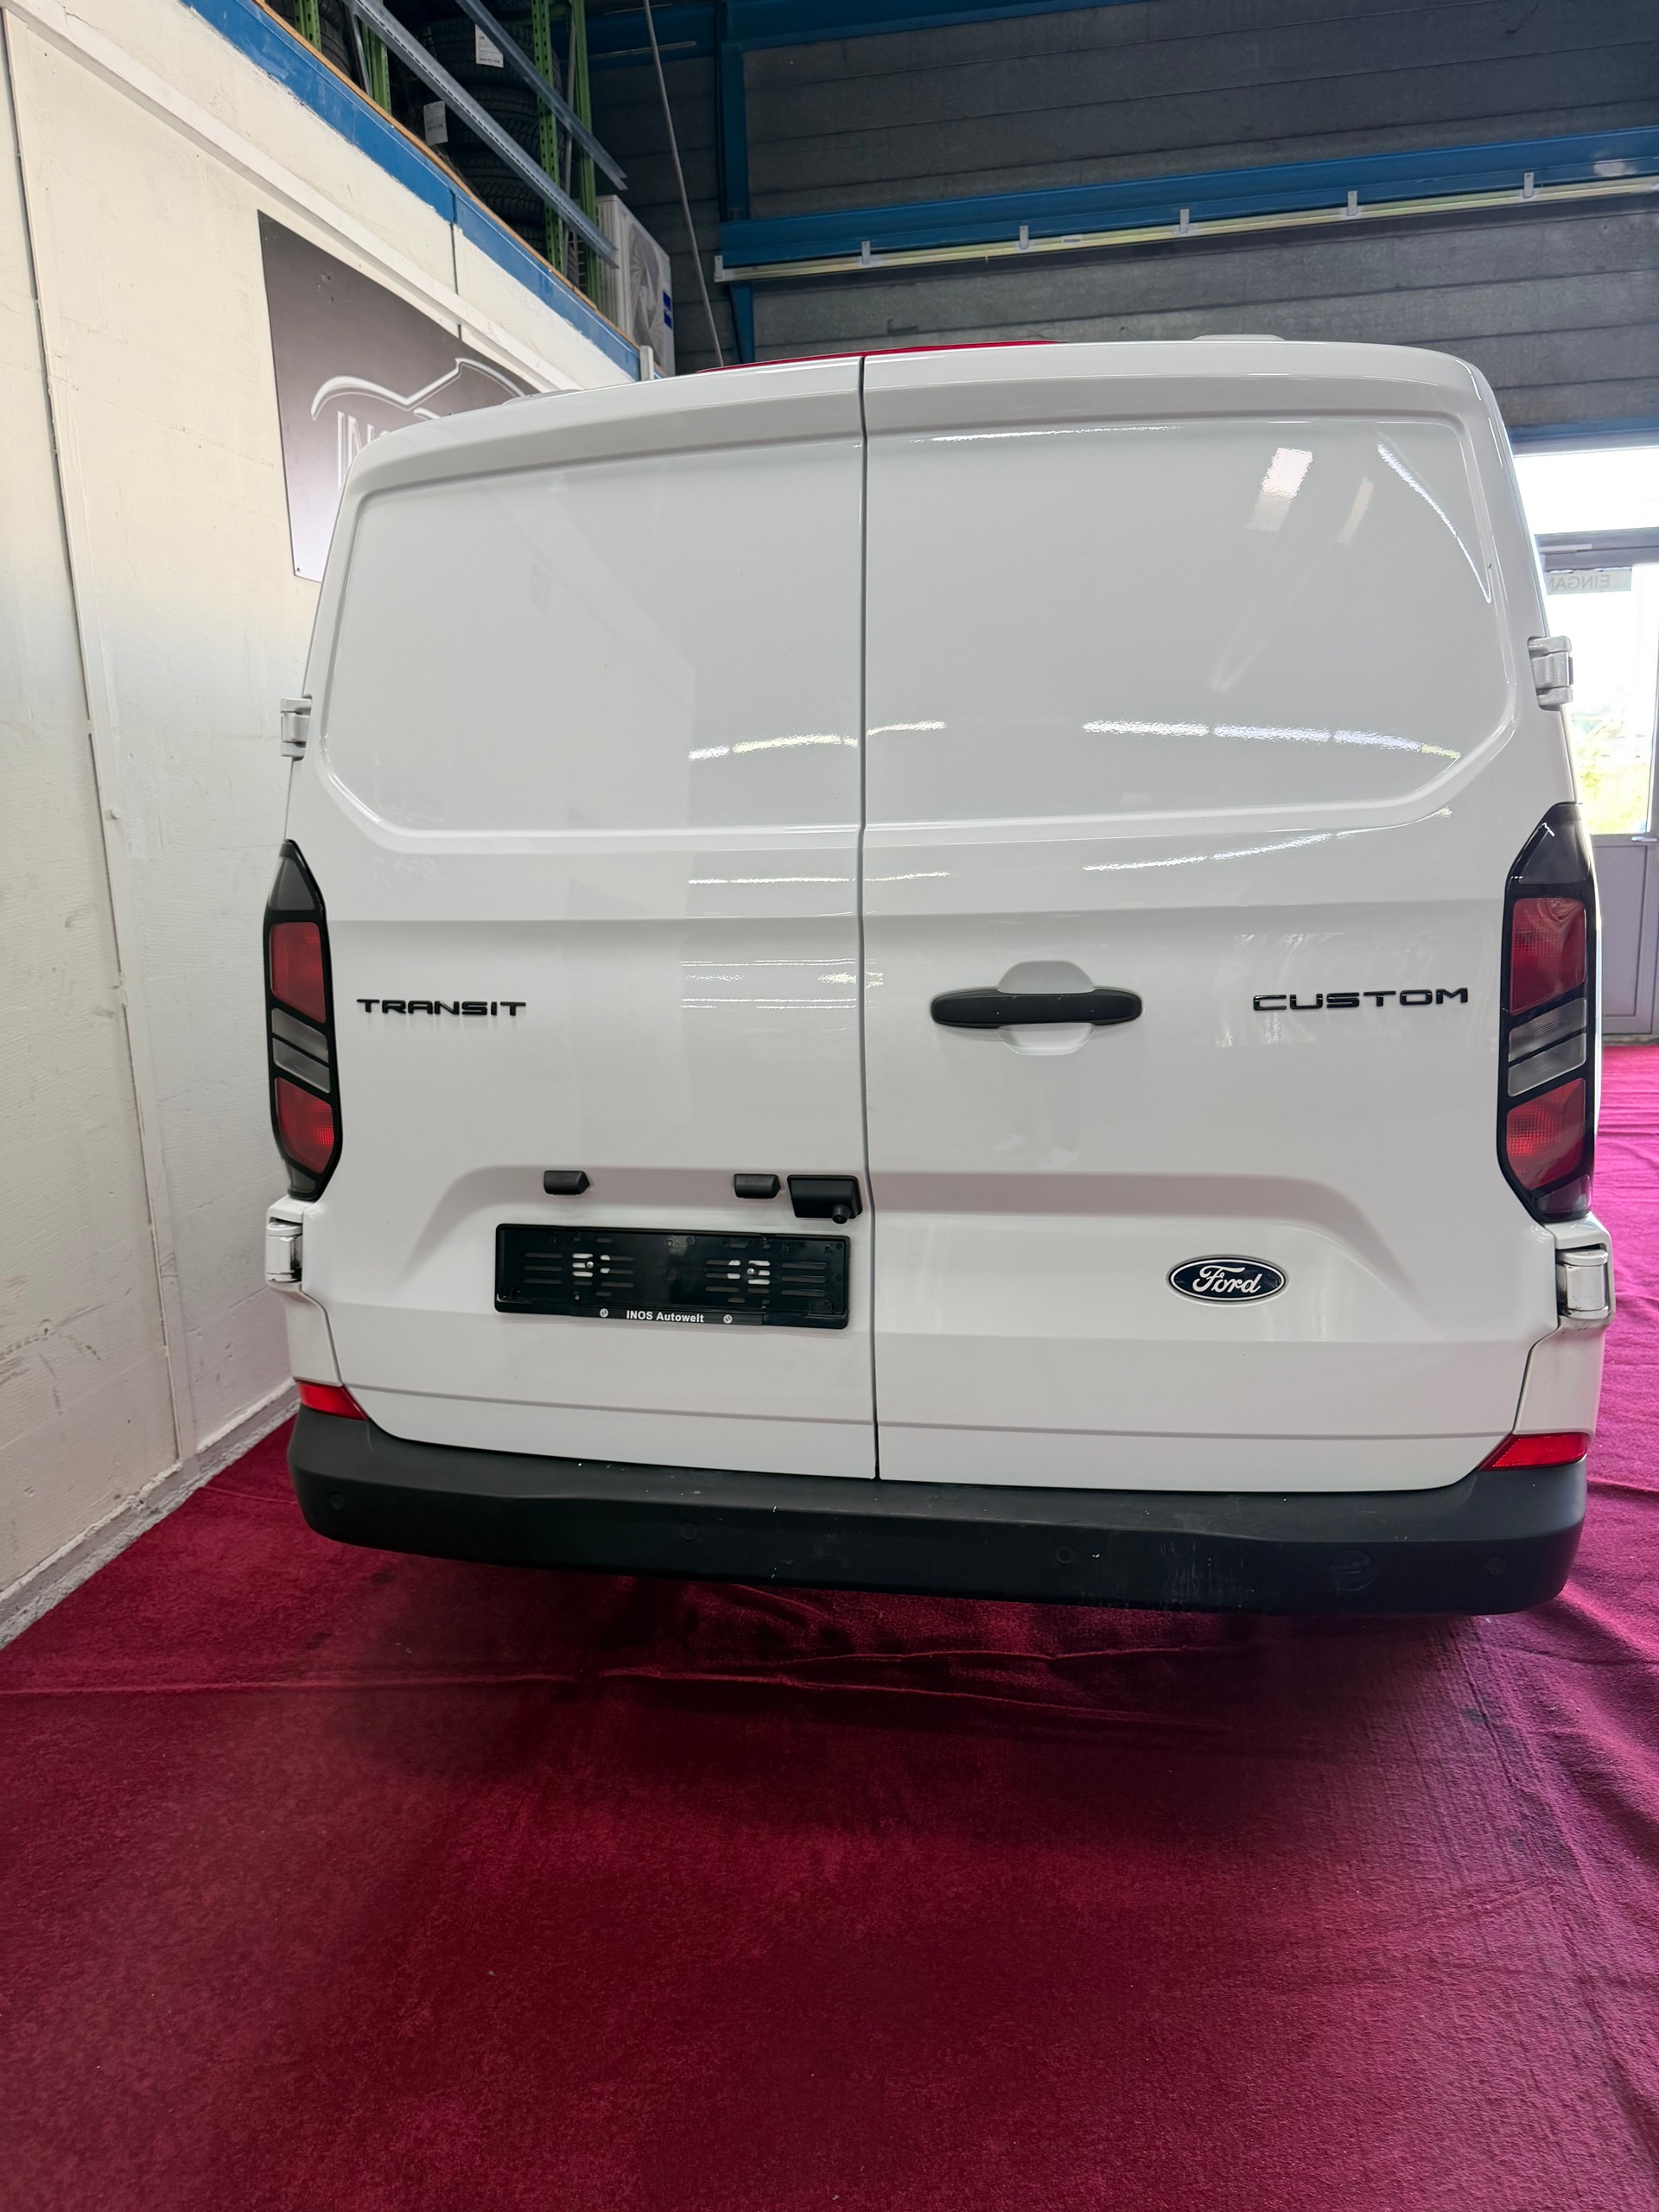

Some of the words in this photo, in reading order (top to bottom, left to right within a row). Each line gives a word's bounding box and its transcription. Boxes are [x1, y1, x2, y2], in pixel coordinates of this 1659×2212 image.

[337, 410, 391, 491] IN
[356, 998, 526, 1016] TRANSIT
[1253, 988, 1468, 1011] CUSTOM
[1192, 1265, 1262, 1294] Ford
[626, 1310, 653, 1320] INOS
[656, 1312, 704, 1323] Autowelt
